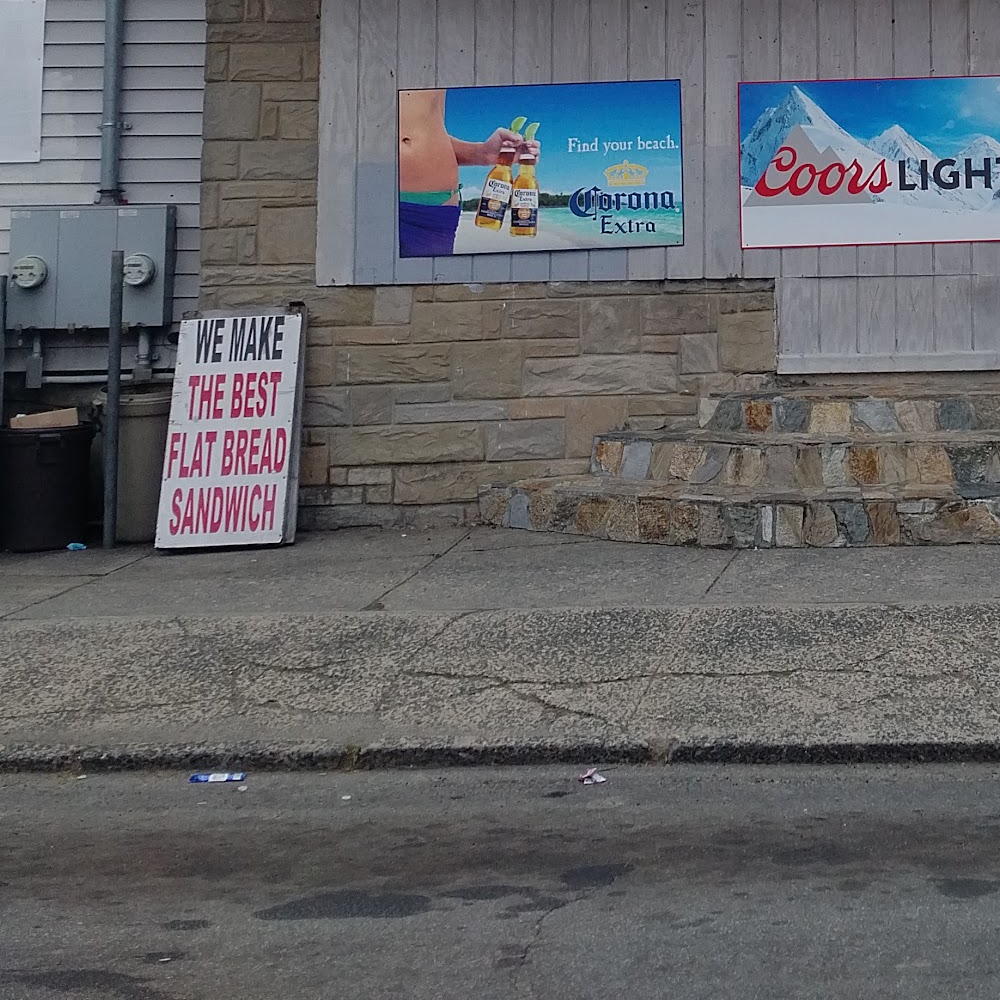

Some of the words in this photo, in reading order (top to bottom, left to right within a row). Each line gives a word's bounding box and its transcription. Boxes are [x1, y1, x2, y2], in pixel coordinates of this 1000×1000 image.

[568, 137, 599, 153] Find
[603, 140, 633, 156] your
[637, 135, 680, 151] beach.
[754, 146, 892, 197] Coors
[569, 185, 676, 221] Corona
[600, 215, 657, 235] Extra
[195, 318, 226, 364] WE
[228, 316, 285, 362] MAKE
[188, 373, 227, 420] THE
[230, 371, 282, 419] BEST
[167, 431, 218, 479] FLAT
[220, 427, 287, 477] BREAD
[169, 483, 277, 536] SANDWICH
